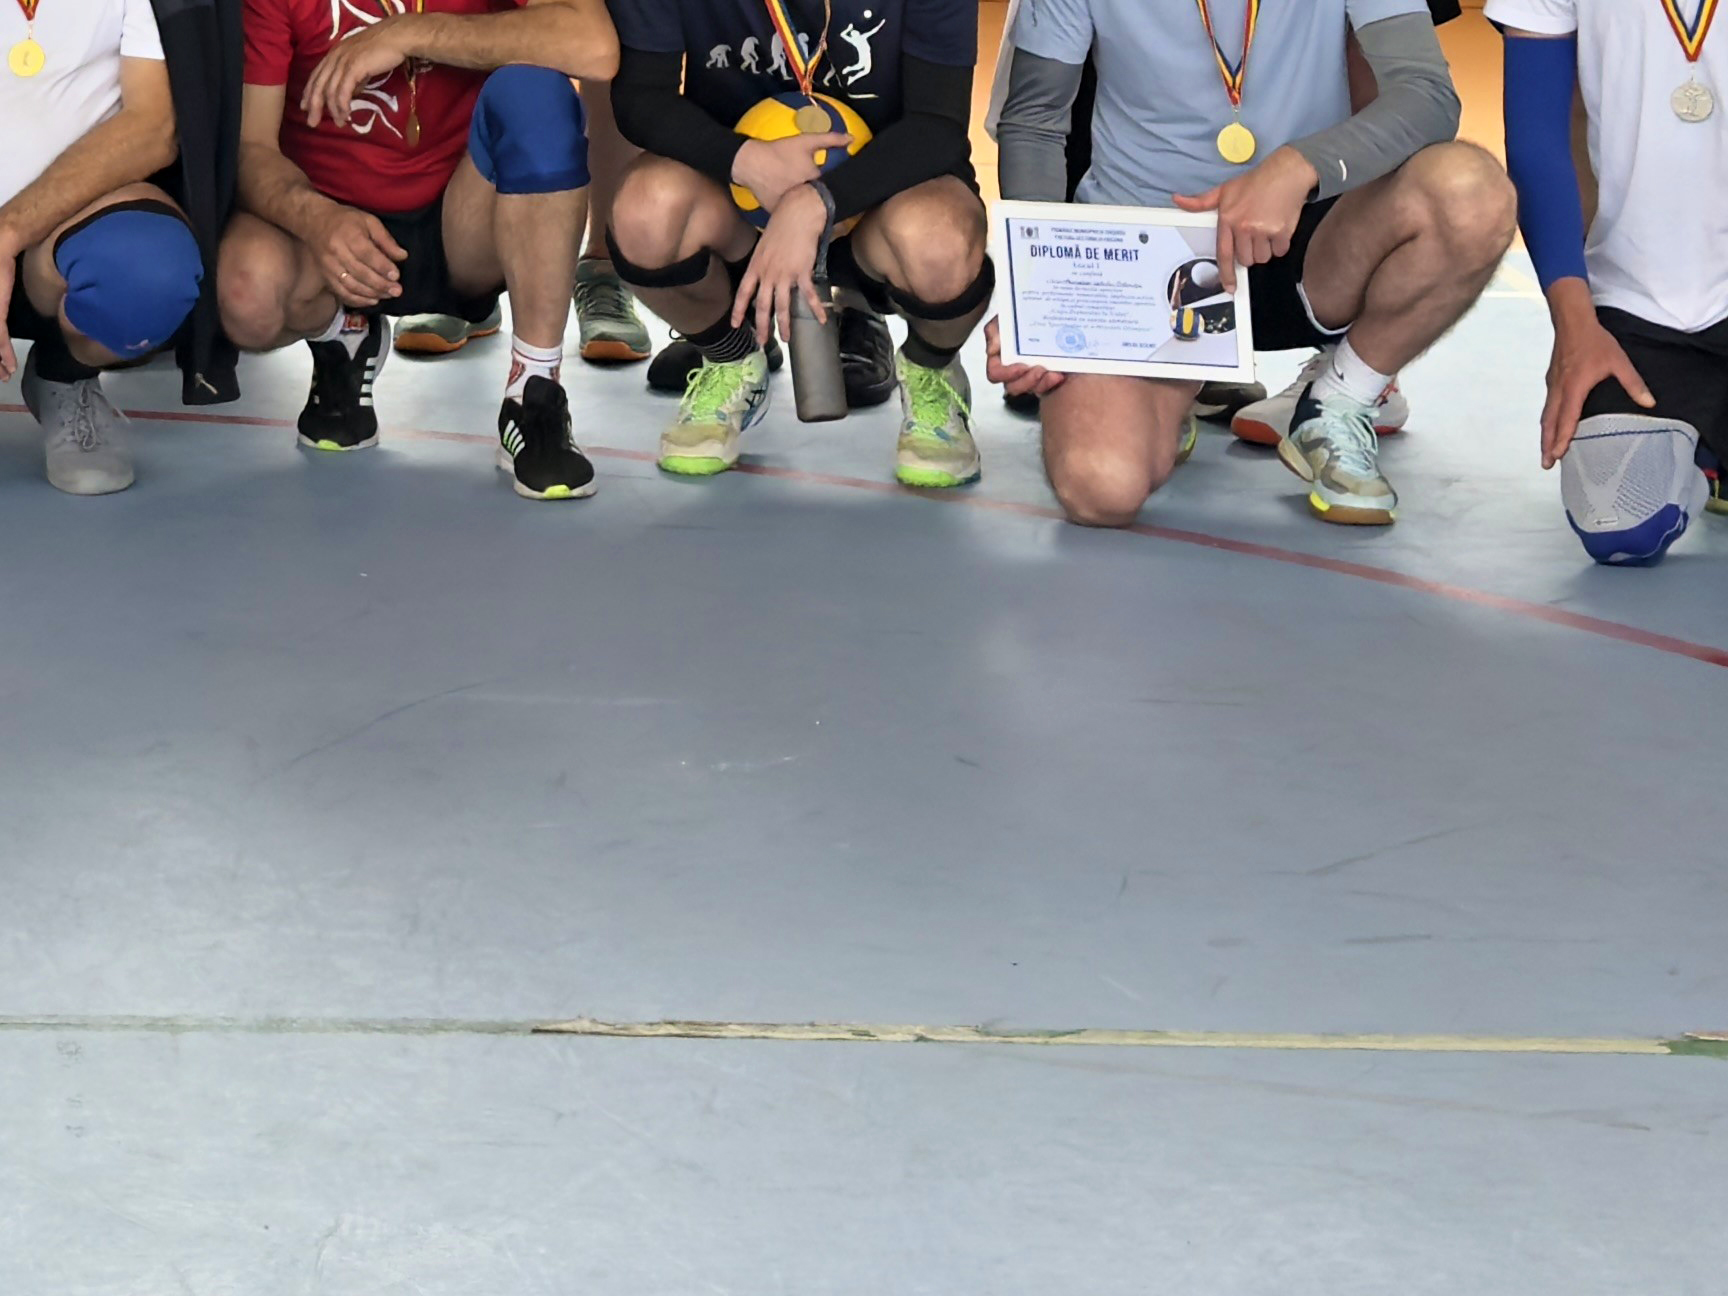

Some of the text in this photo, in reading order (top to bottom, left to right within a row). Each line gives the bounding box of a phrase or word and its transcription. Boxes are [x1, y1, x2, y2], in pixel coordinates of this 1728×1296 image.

[1030, 244, 1140, 261] DIPLOMĂ DE MERIT
